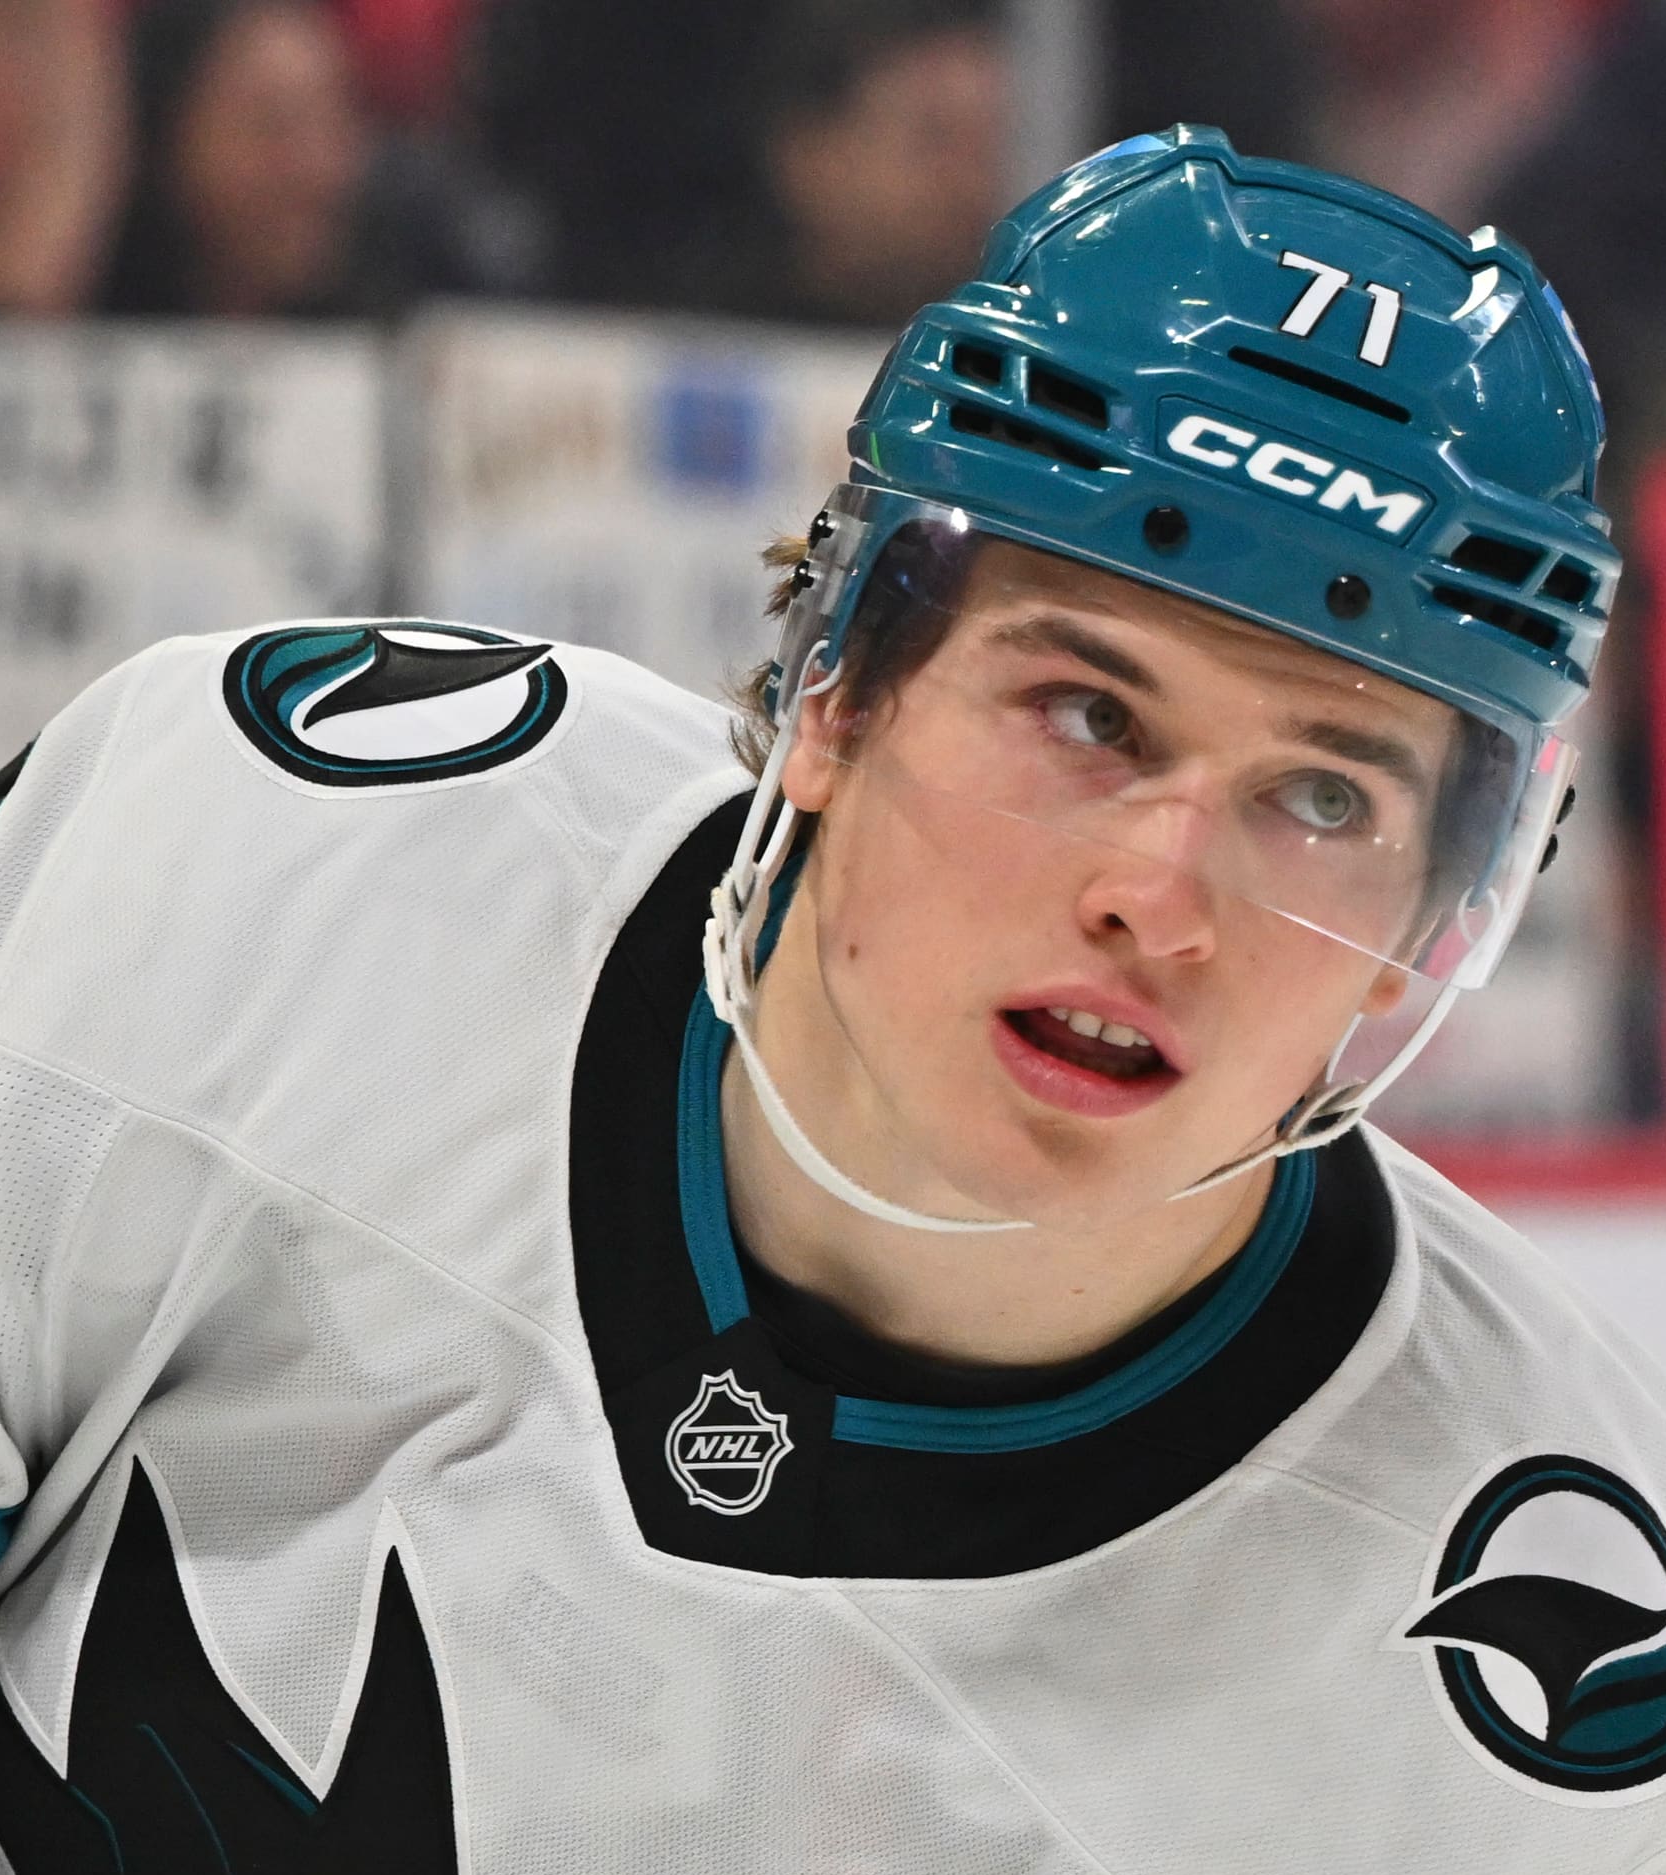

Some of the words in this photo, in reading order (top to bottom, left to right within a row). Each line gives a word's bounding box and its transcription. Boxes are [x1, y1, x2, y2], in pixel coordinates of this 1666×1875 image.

[1277, 249, 1403, 368] 71
[1166, 414, 1425, 534] CCM
[684, 1434, 762, 1460] NHL
